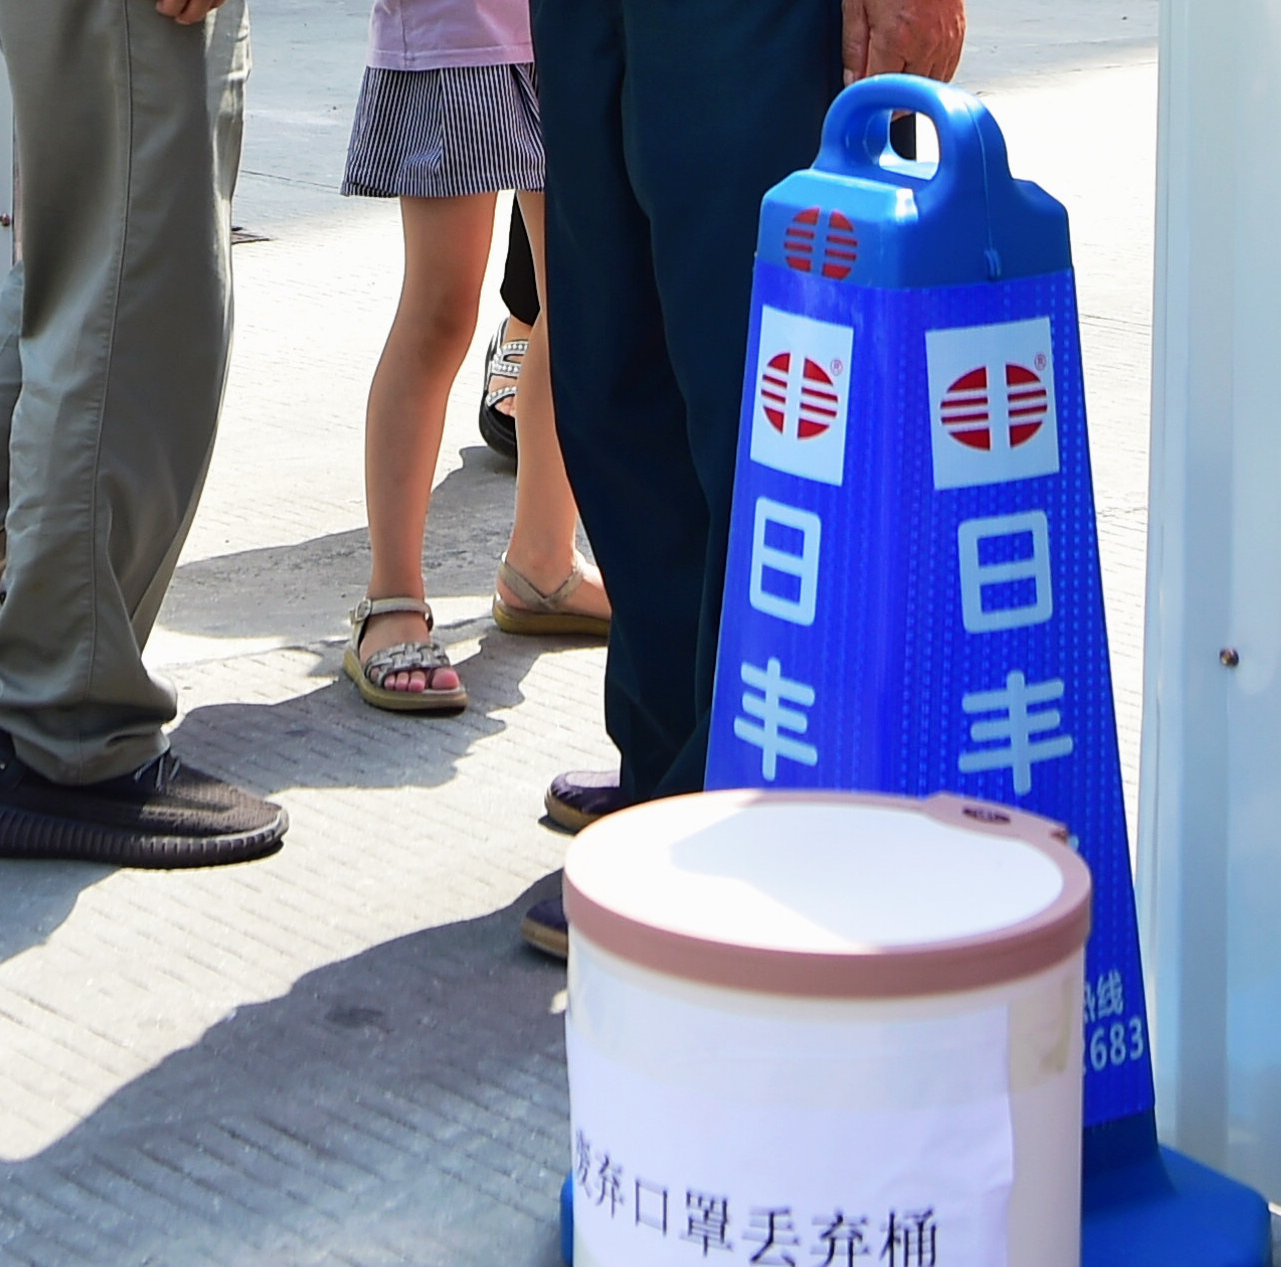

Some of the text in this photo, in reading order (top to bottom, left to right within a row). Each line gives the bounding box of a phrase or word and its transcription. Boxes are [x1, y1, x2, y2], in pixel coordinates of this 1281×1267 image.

[733, 495, 822, 782] 日丰
[957, 509, 1074, 796] 日丰
[1084, 1015, 1144, 1074] 683
